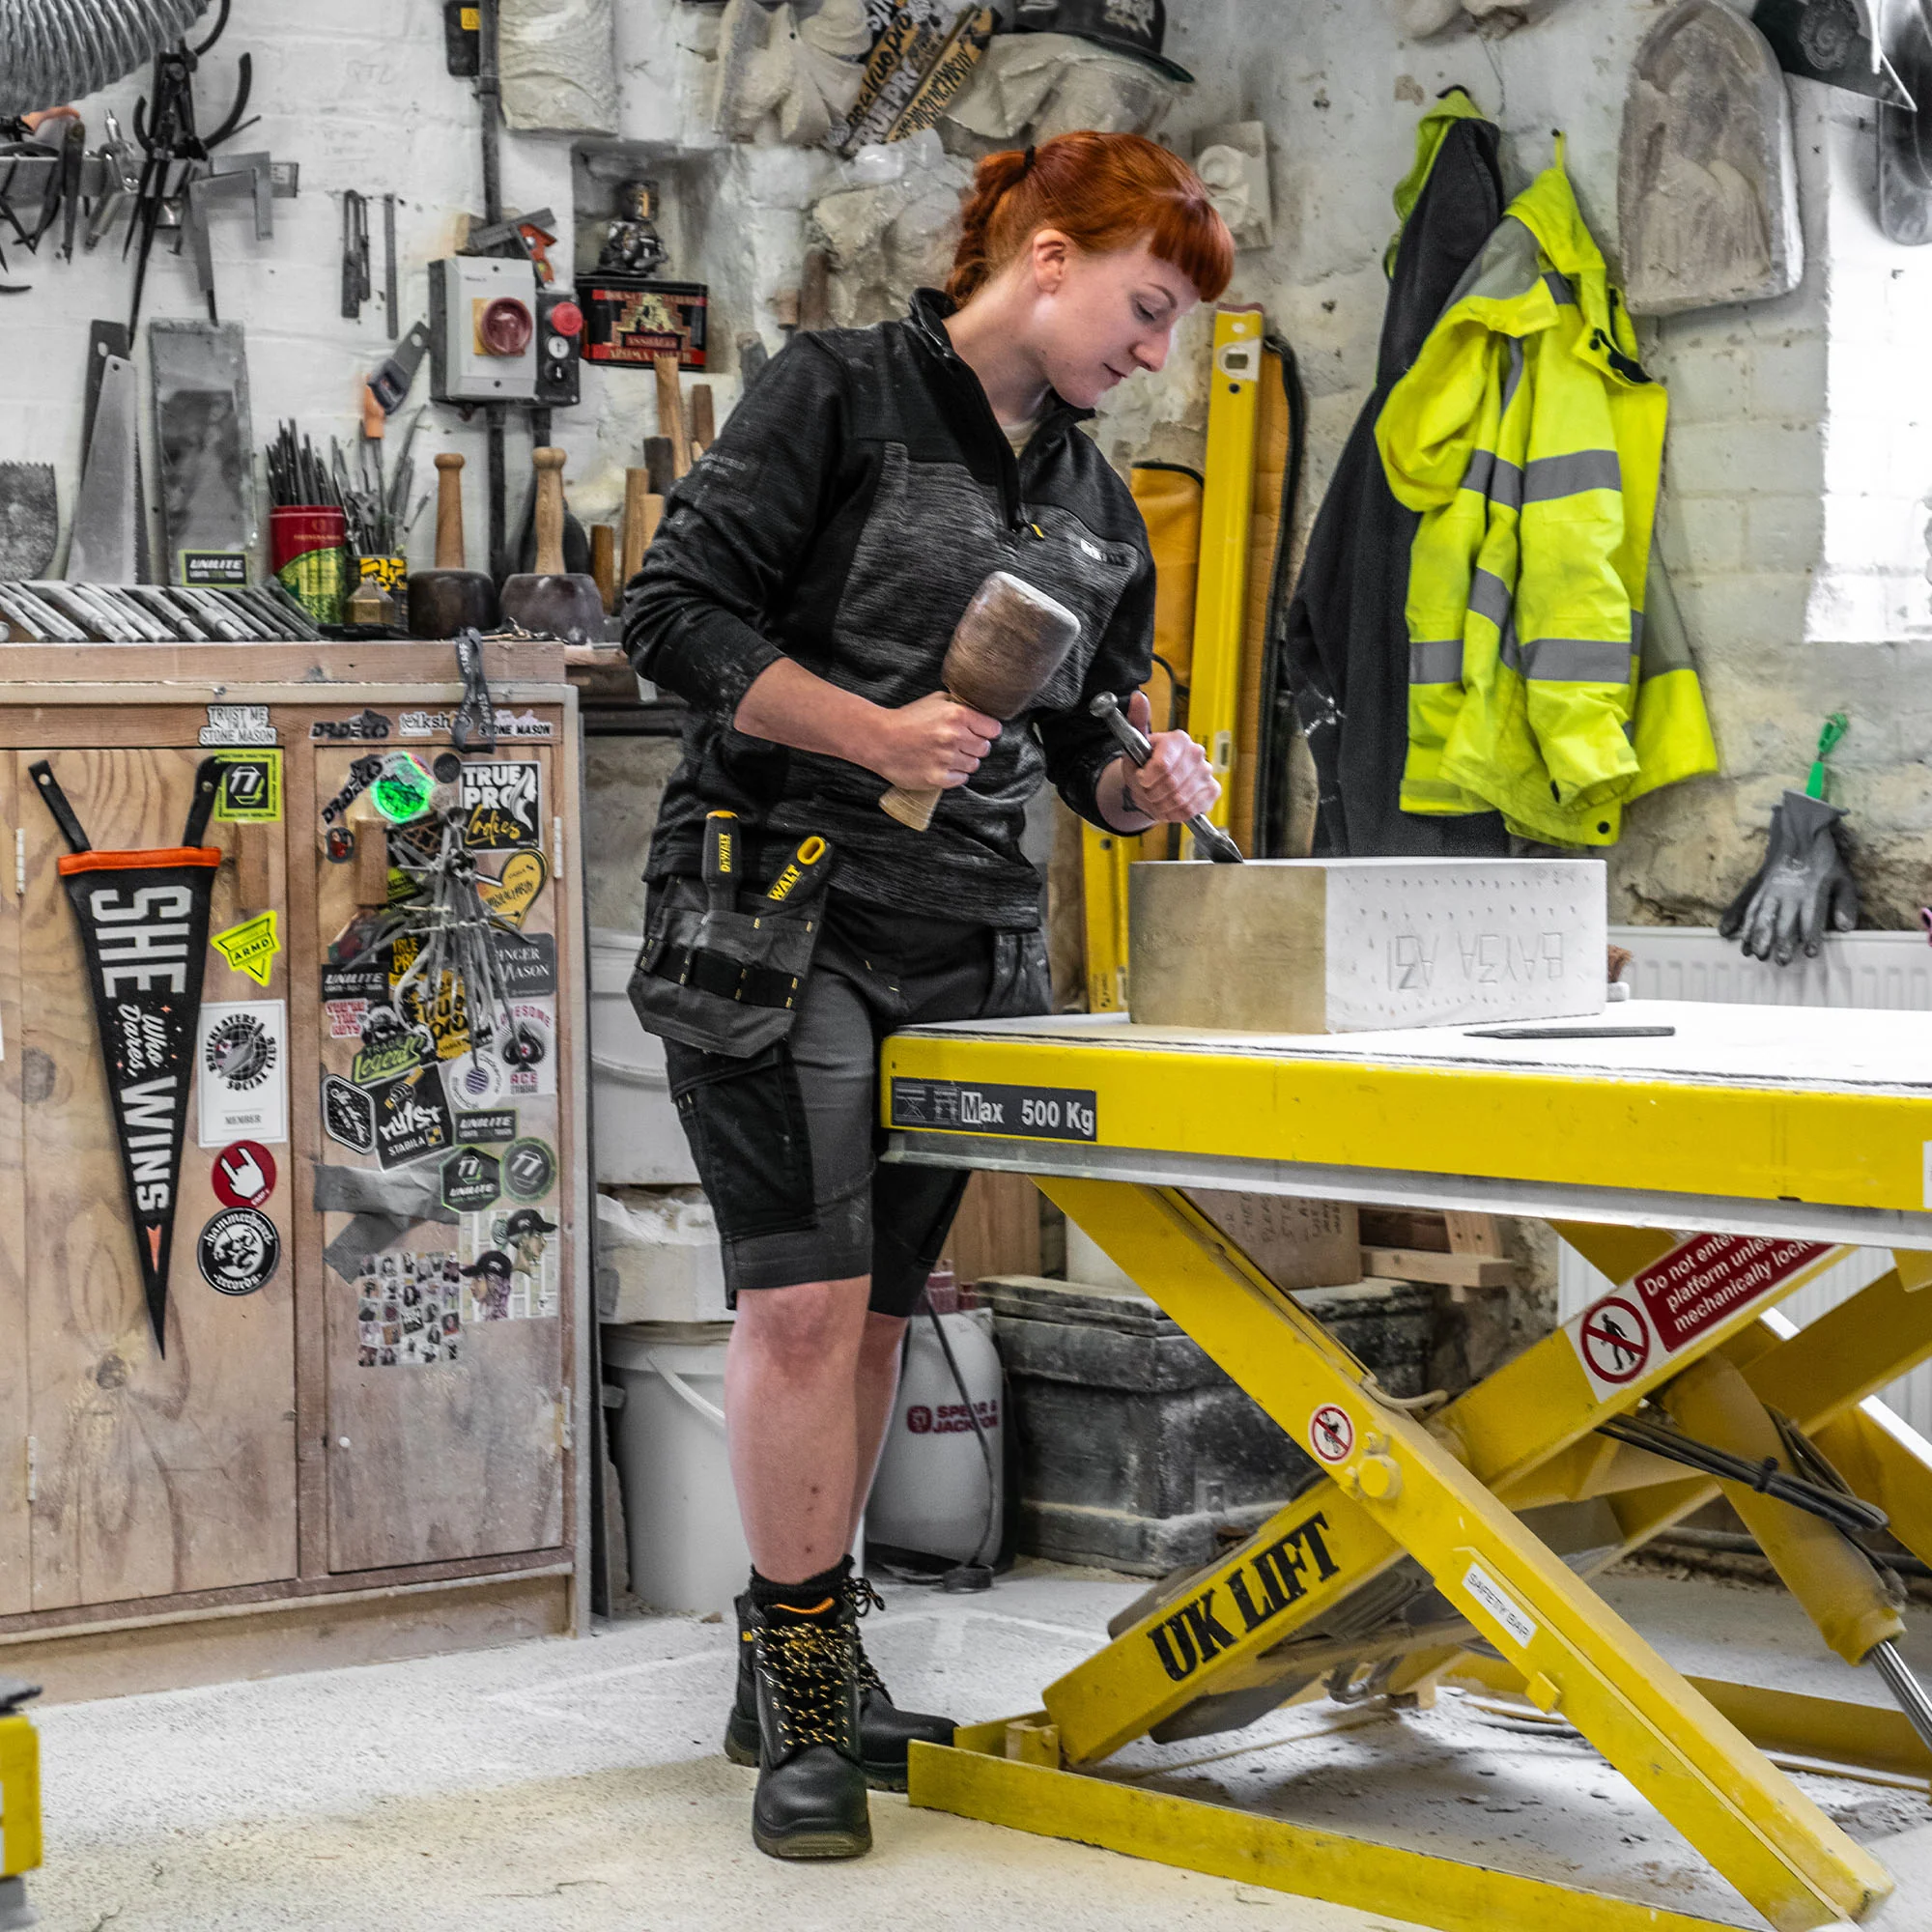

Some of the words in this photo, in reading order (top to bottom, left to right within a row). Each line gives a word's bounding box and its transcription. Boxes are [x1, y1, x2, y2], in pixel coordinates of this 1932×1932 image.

[202, 728, 234, 742] STONE
[237, 728, 273, 743] MASON
[480, 724, 512, 736] SONE
[517, 724, 551, 736] MASON
[464, 765, 522, 786] TRUE
[766, 864, 803, 902] WALT
[89, 885, 193, 999] SHE
[495, 947, 541, 961] INGER
[324, 972, 384, 984] UNILITE
[497, 1005, 551, 1030] AESOME
[510, 1072, 538, 1085] ACE
[961, 1091, 1005, 1123] Max
[1021, 1098, 1062, 1128] 500
[1065, 1100, 1094, 1137] Kg
[120, 1074, 178, 1211] WINS
[387, 1136, 426, 1157] STABILA
[1642, 1277, 1669, 1297] Do
[1668, 1255, 1698, 1280] not
[1665, 1261, 1731, 1313] platform
[1729, 1236, 1776, 1268] unles
[1673, 1260, 1773, 1333] mechanically
[932, 1414, 999, 1435] JACKON
[1147, 1588, 1239, 1682] UK
[1224, 1511, 1341, 1634] LIFT
[1467, 1573, 1509, 1615] SAFETY
[1507, 1612, 1531, 1639] BAR
